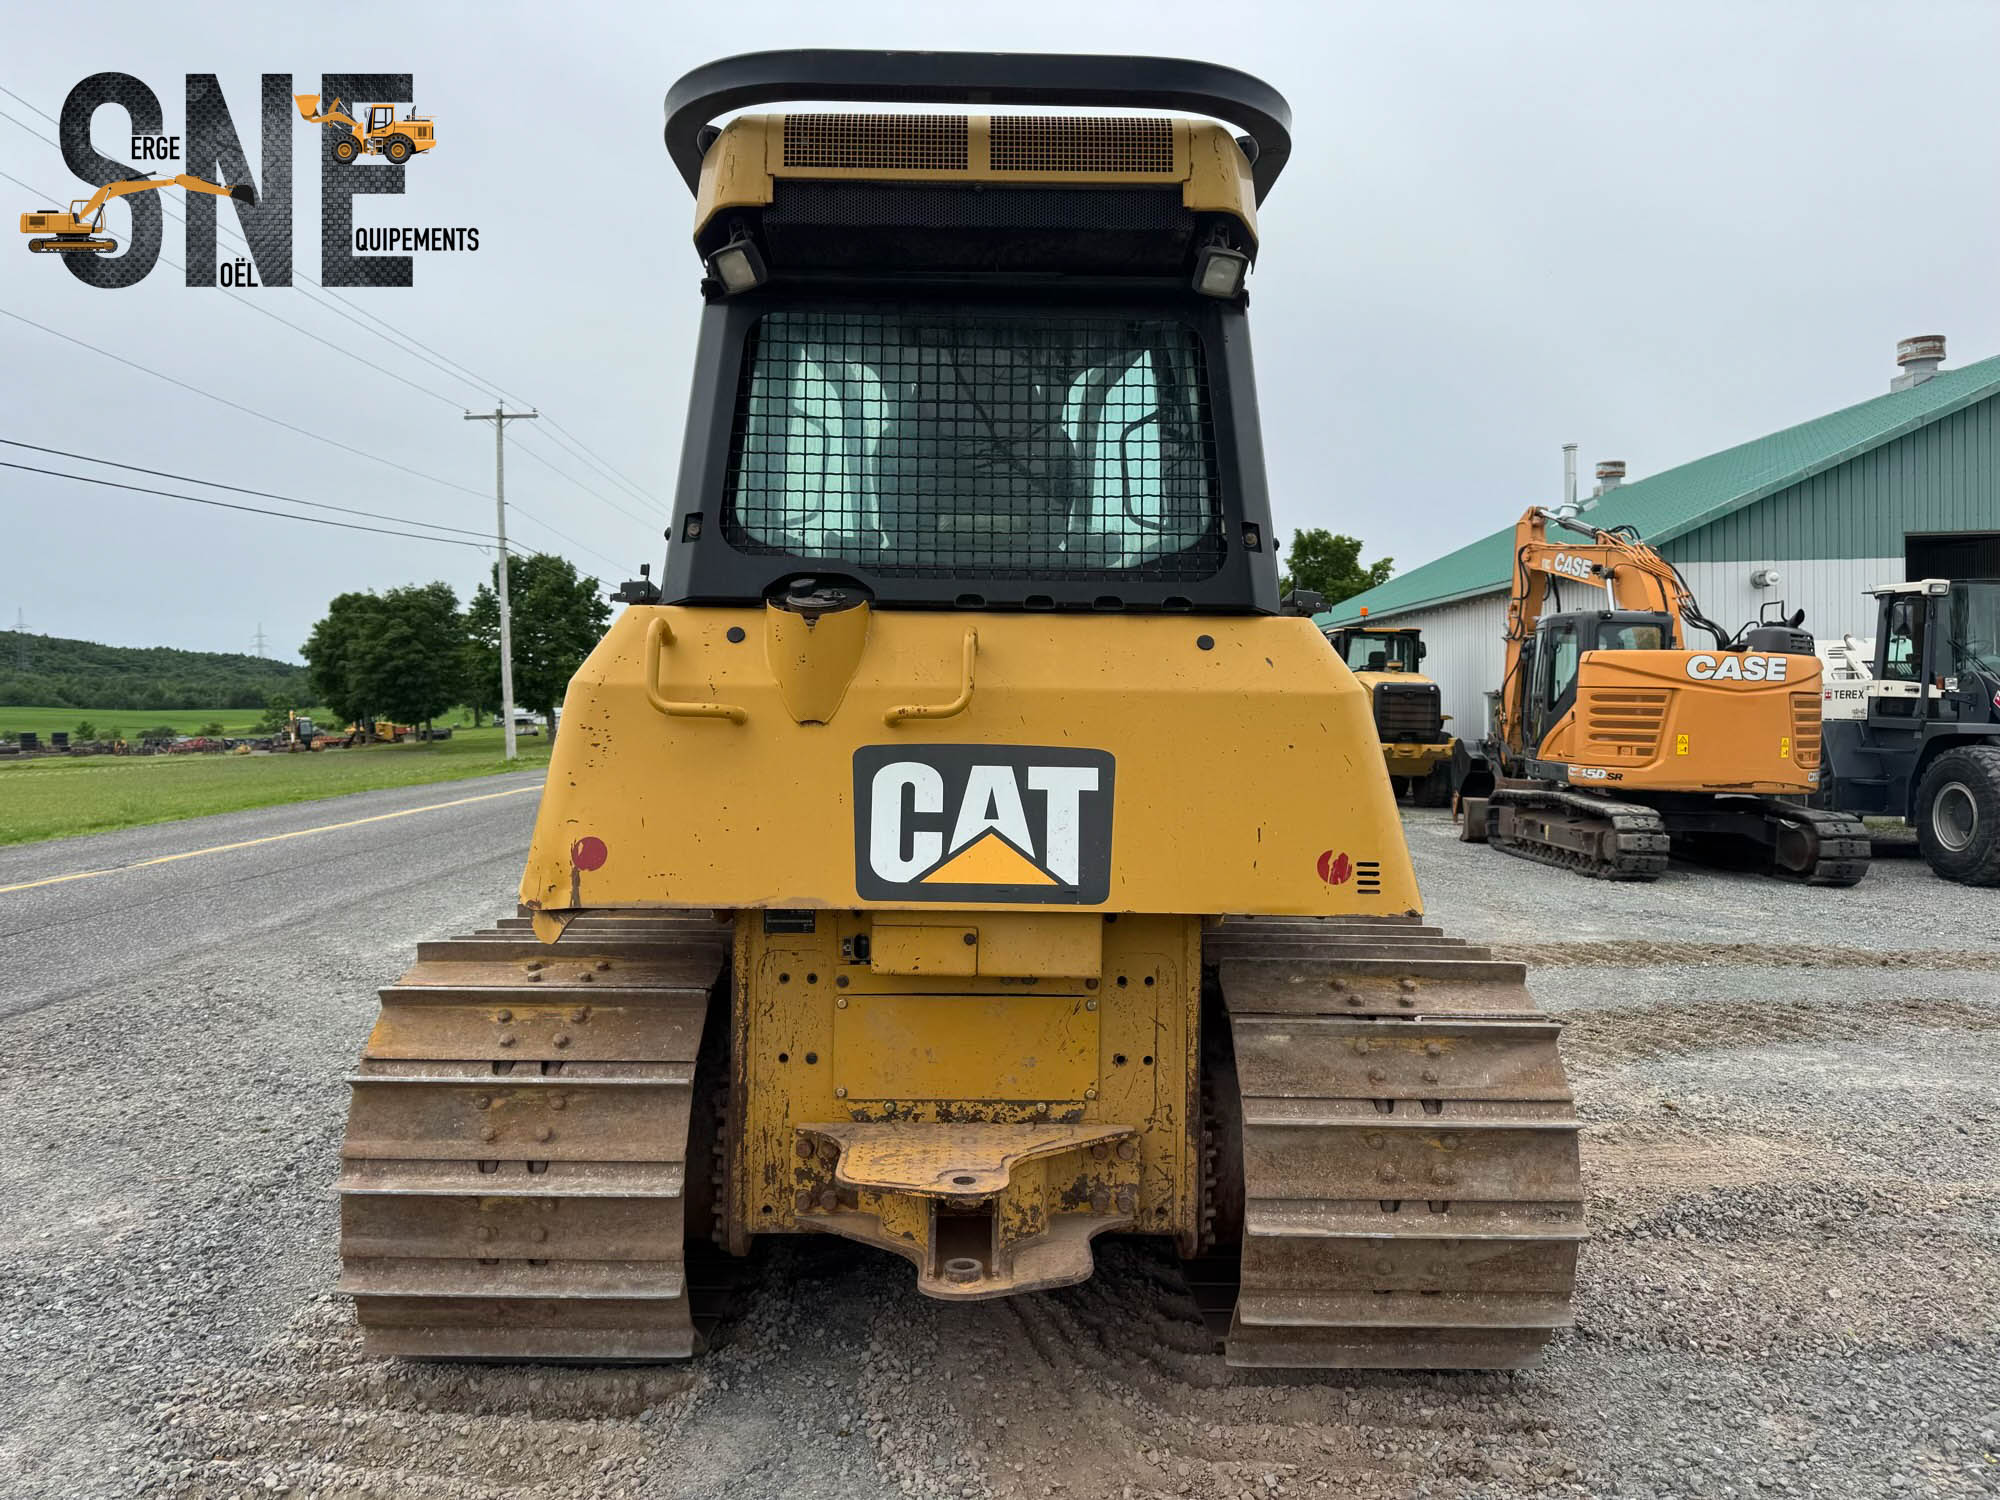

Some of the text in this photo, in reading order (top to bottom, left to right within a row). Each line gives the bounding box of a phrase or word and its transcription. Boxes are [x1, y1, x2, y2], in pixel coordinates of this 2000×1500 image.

[1554, 551, 1593, 579] CASE
[1686, 654, 1787, 681] CASE
[1833, 689, 1865, 700] TEREX
[1607, 772, 1624, 781] SR
[869, 761, 1099, 886] CAT
